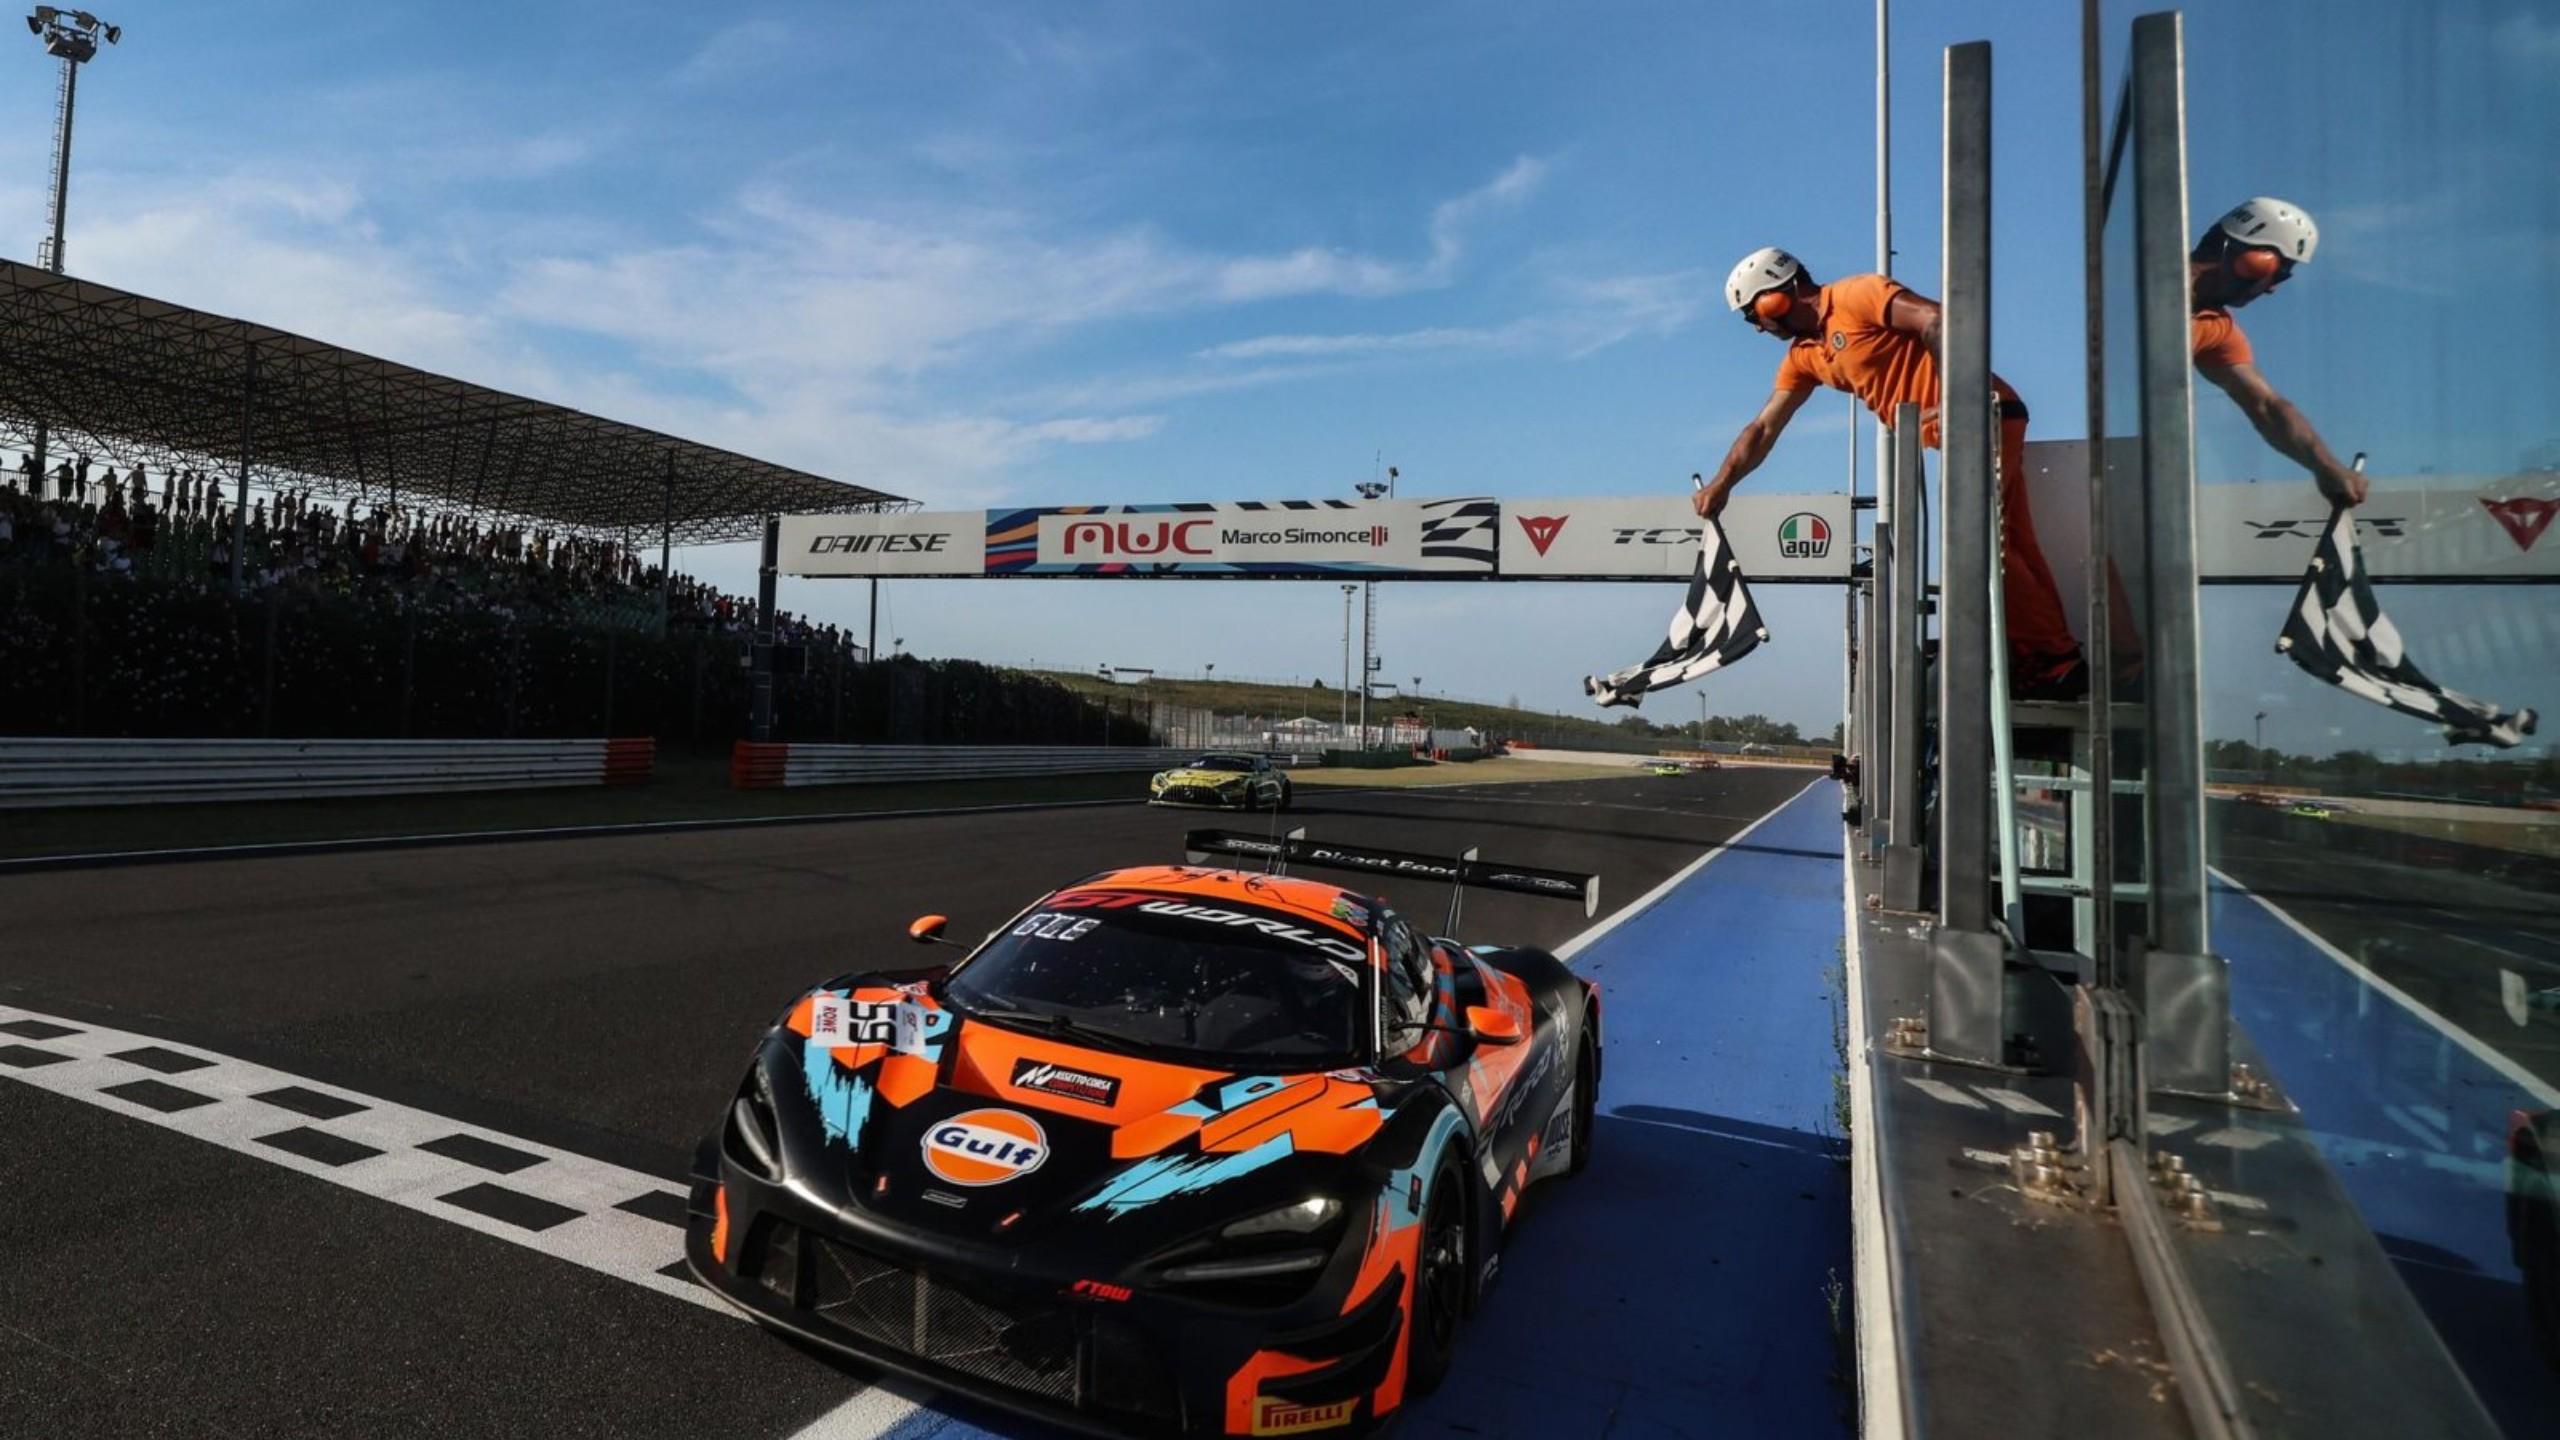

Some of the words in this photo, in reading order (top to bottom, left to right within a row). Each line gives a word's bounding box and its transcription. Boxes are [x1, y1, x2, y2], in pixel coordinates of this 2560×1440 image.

[809, 533, 951, 553] DAINESE
[1222, 529, 1281, 544] Marco
[1284, 525, 1388, 546] Simoncelli
[1311, 849, 1391, 867] Direct
[1138, 901, 1366, 961] WORLD
[822, 1005, 838, 1034] ROWE
[848, 1000, 897, 1048] 59
[935, 1127, 1038, 1165] Gulf
[1261, 1403, 1343, 1428] PIRELLI
